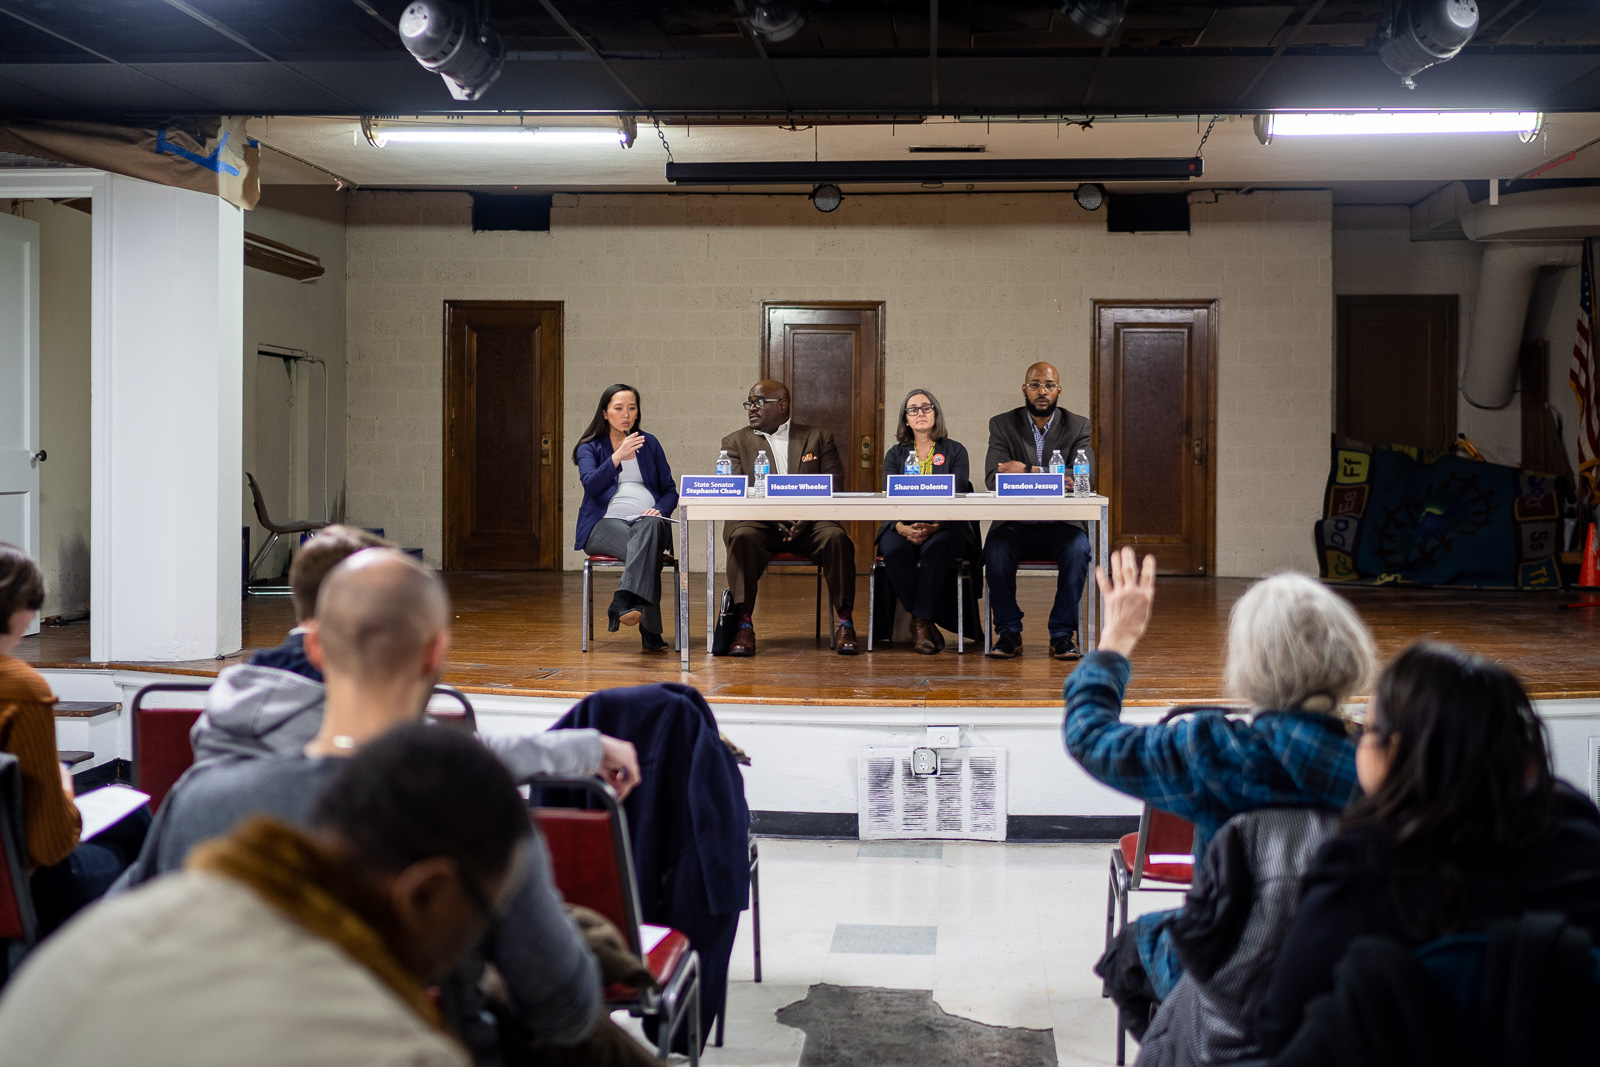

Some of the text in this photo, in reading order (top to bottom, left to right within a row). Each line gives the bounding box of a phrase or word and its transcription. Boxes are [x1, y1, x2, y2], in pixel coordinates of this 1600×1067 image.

[1343, 457, 1362, 477] Ff
[693, 481, 735, 489] State Senator
[770, 483, 828, 491] Heaster Wheeler
[894, 483, 948, 491] Sharon Dolente
[1002, 482, 1058, 492] Brandon Jessup
[685, 487, 741, 496] Stephanie Chang
[1338, 490, 1357, 513] Ee
[1530, 531, 1549, 551] Ss
[1529, 565, 1550, 585] Tt
